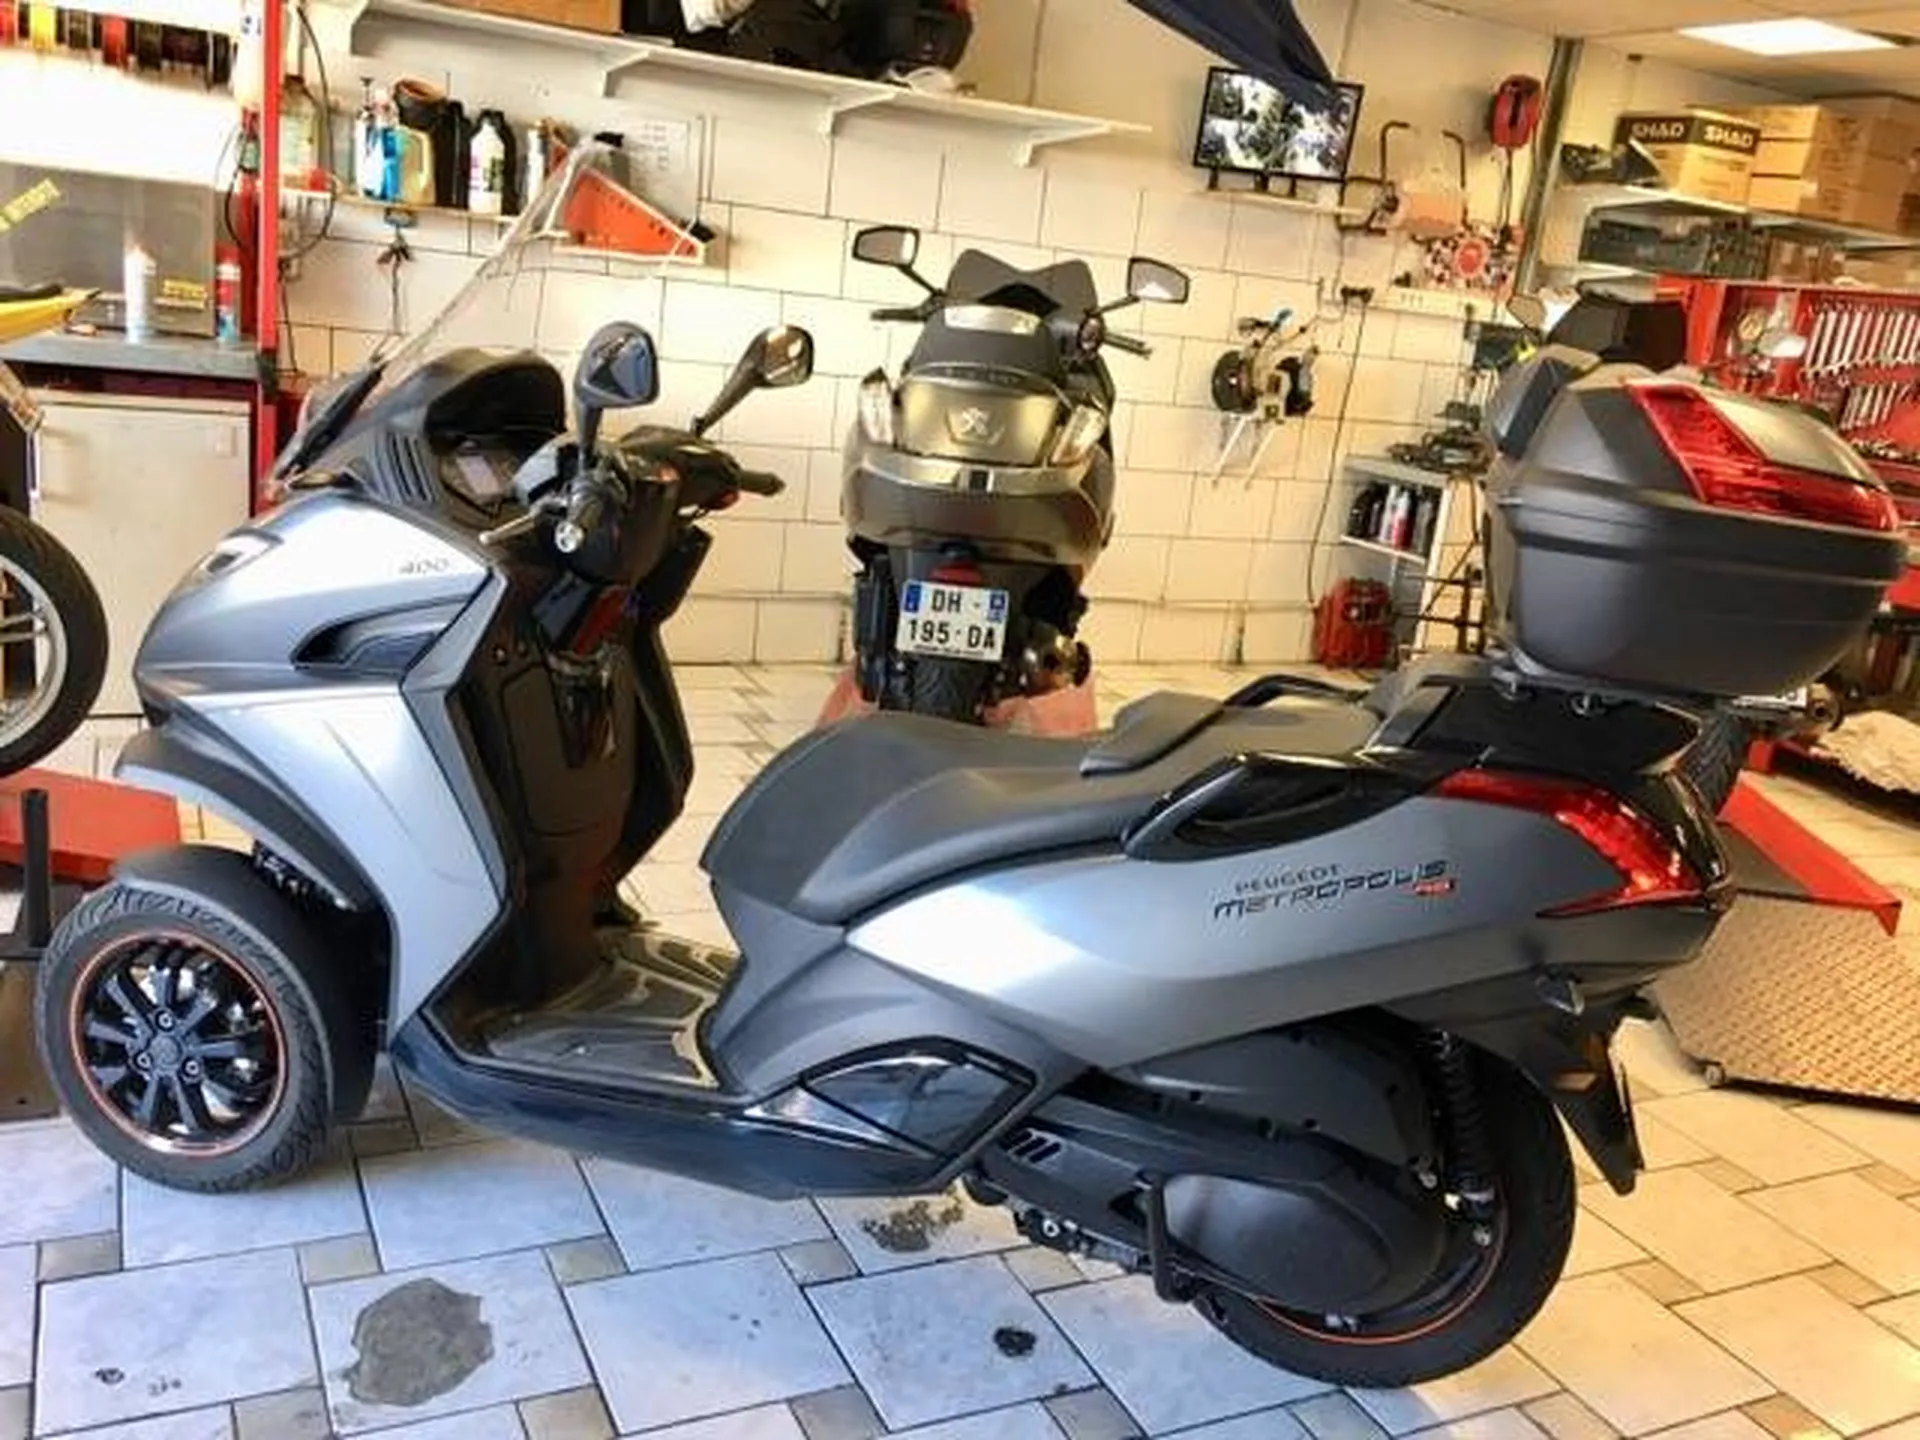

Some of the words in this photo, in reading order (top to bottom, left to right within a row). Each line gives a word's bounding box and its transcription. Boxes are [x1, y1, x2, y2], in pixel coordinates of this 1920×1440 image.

[1631, 121, 1685, 140] SHAD
[1704, 124, 1754, 149] SHAD
[931, 588, 963, 614] DH
[1234, 863, 1341, 895] PEUGEOT
